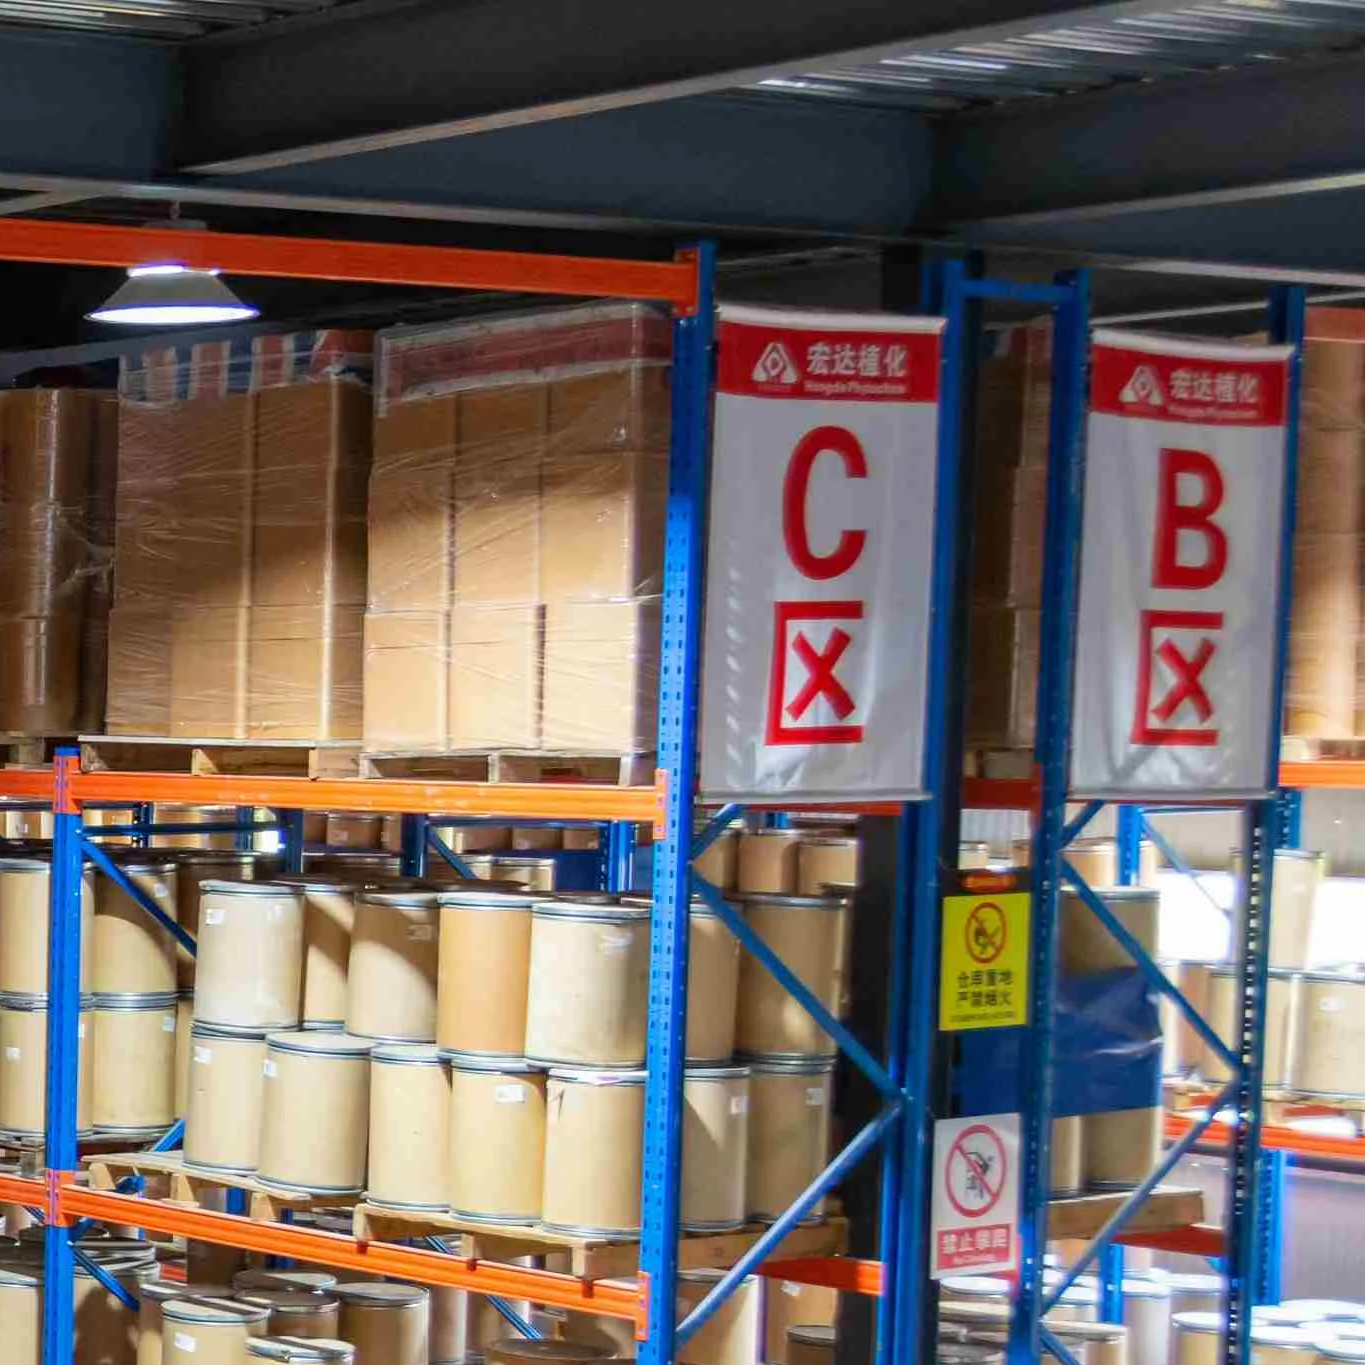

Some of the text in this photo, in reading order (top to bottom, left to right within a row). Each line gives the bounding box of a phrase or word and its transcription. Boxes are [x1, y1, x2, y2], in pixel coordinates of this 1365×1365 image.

[782, 426, 867, 580] C
[1151, 447, 1227, 590] B
[765, 601, 864, 746] 区
[1131, 610, 1224, 746] 区
